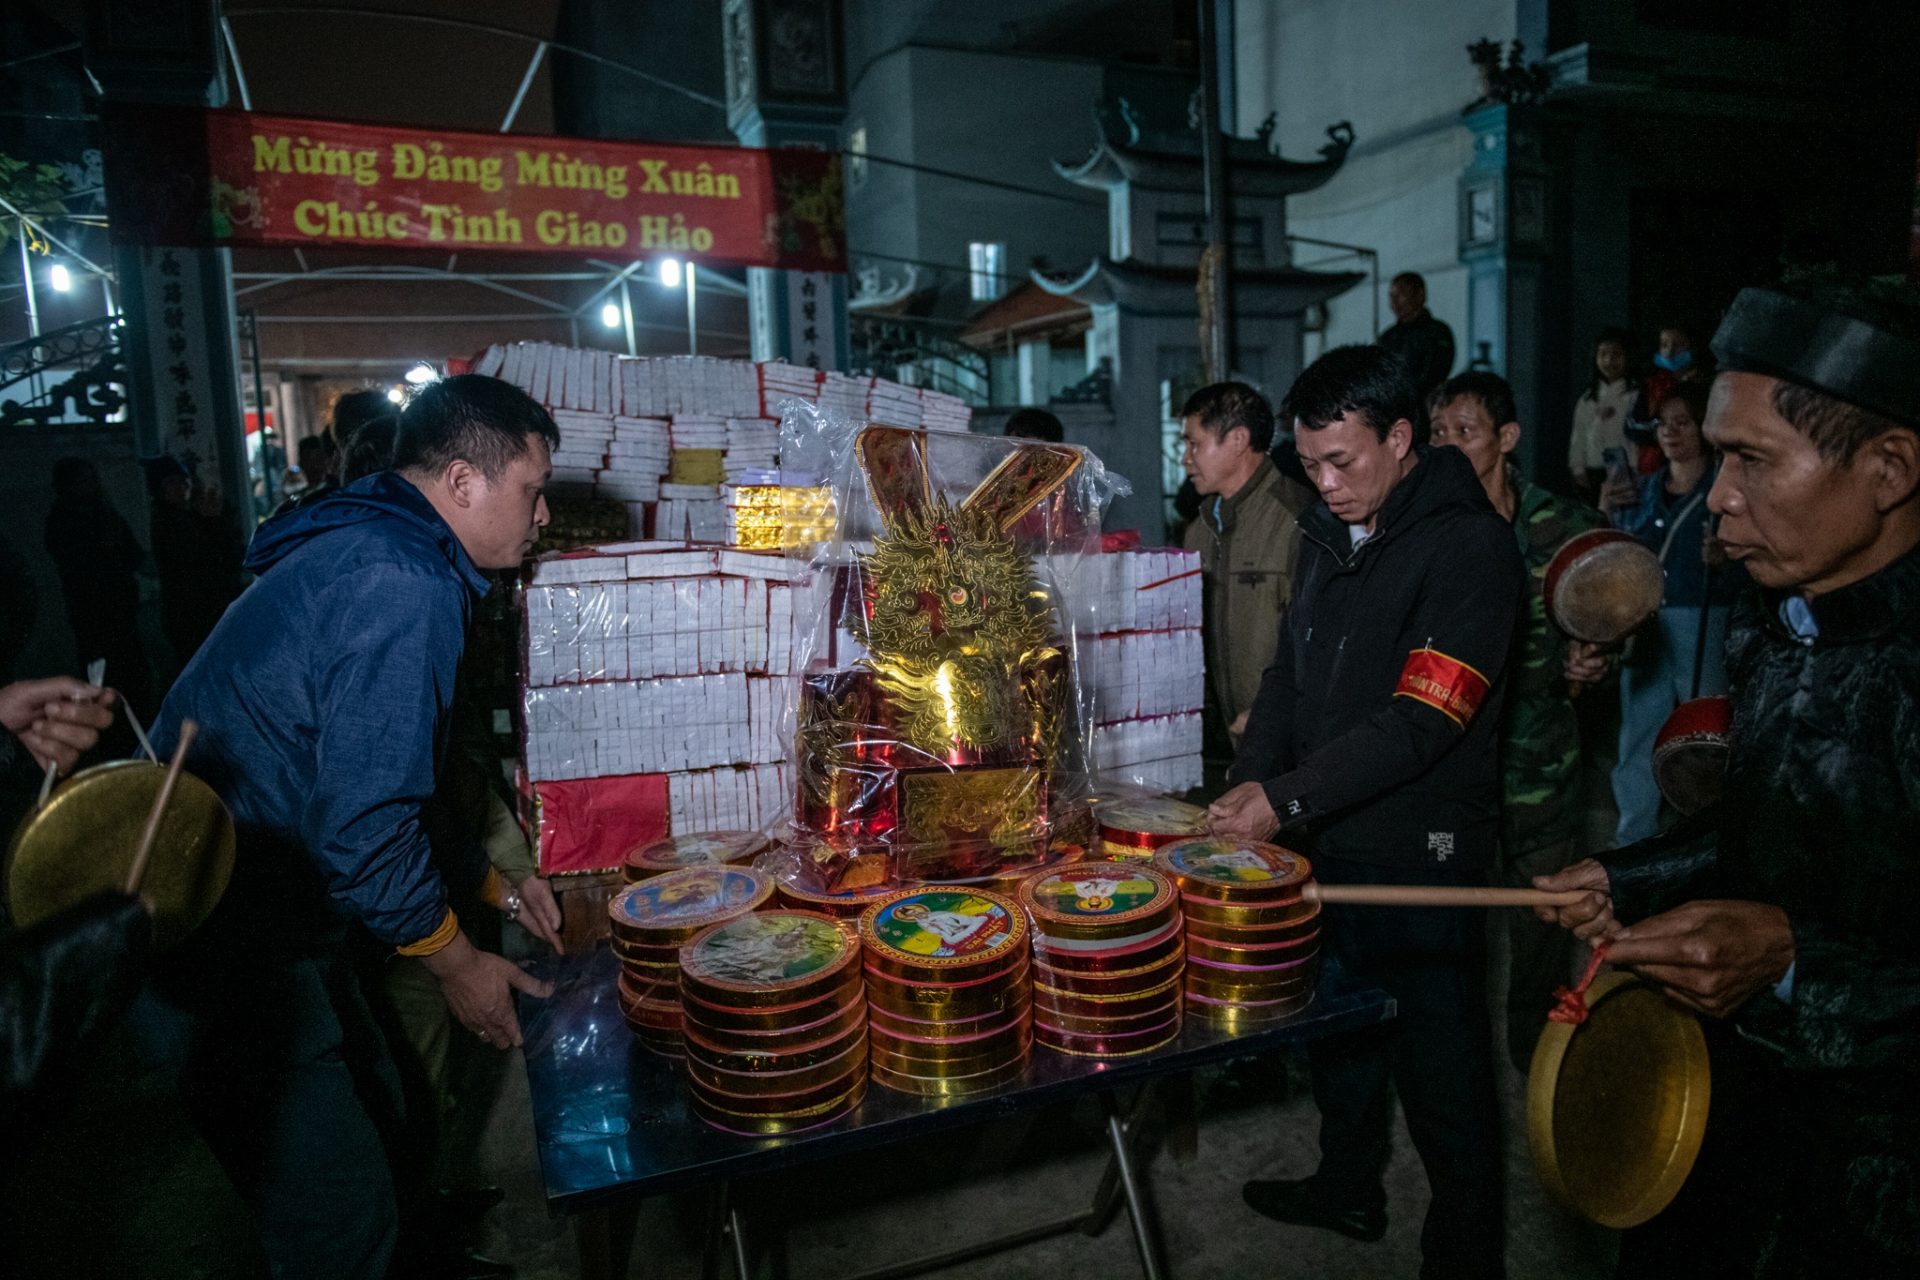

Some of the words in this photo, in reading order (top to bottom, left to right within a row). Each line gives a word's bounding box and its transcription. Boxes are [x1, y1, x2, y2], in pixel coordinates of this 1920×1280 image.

[251, 135, 380, 186] Mừng
[392, 141, 504, 192] Đảng
[516, 150, 629, 199] Mừng
[638, 159, 741, 198] Xuân
[293, 200, 409, 239] Chúc
[421, 204, 522, 243] Tình
[535, 210, 627, 248] Giao
[639, 212, 714, 252] Hảo
